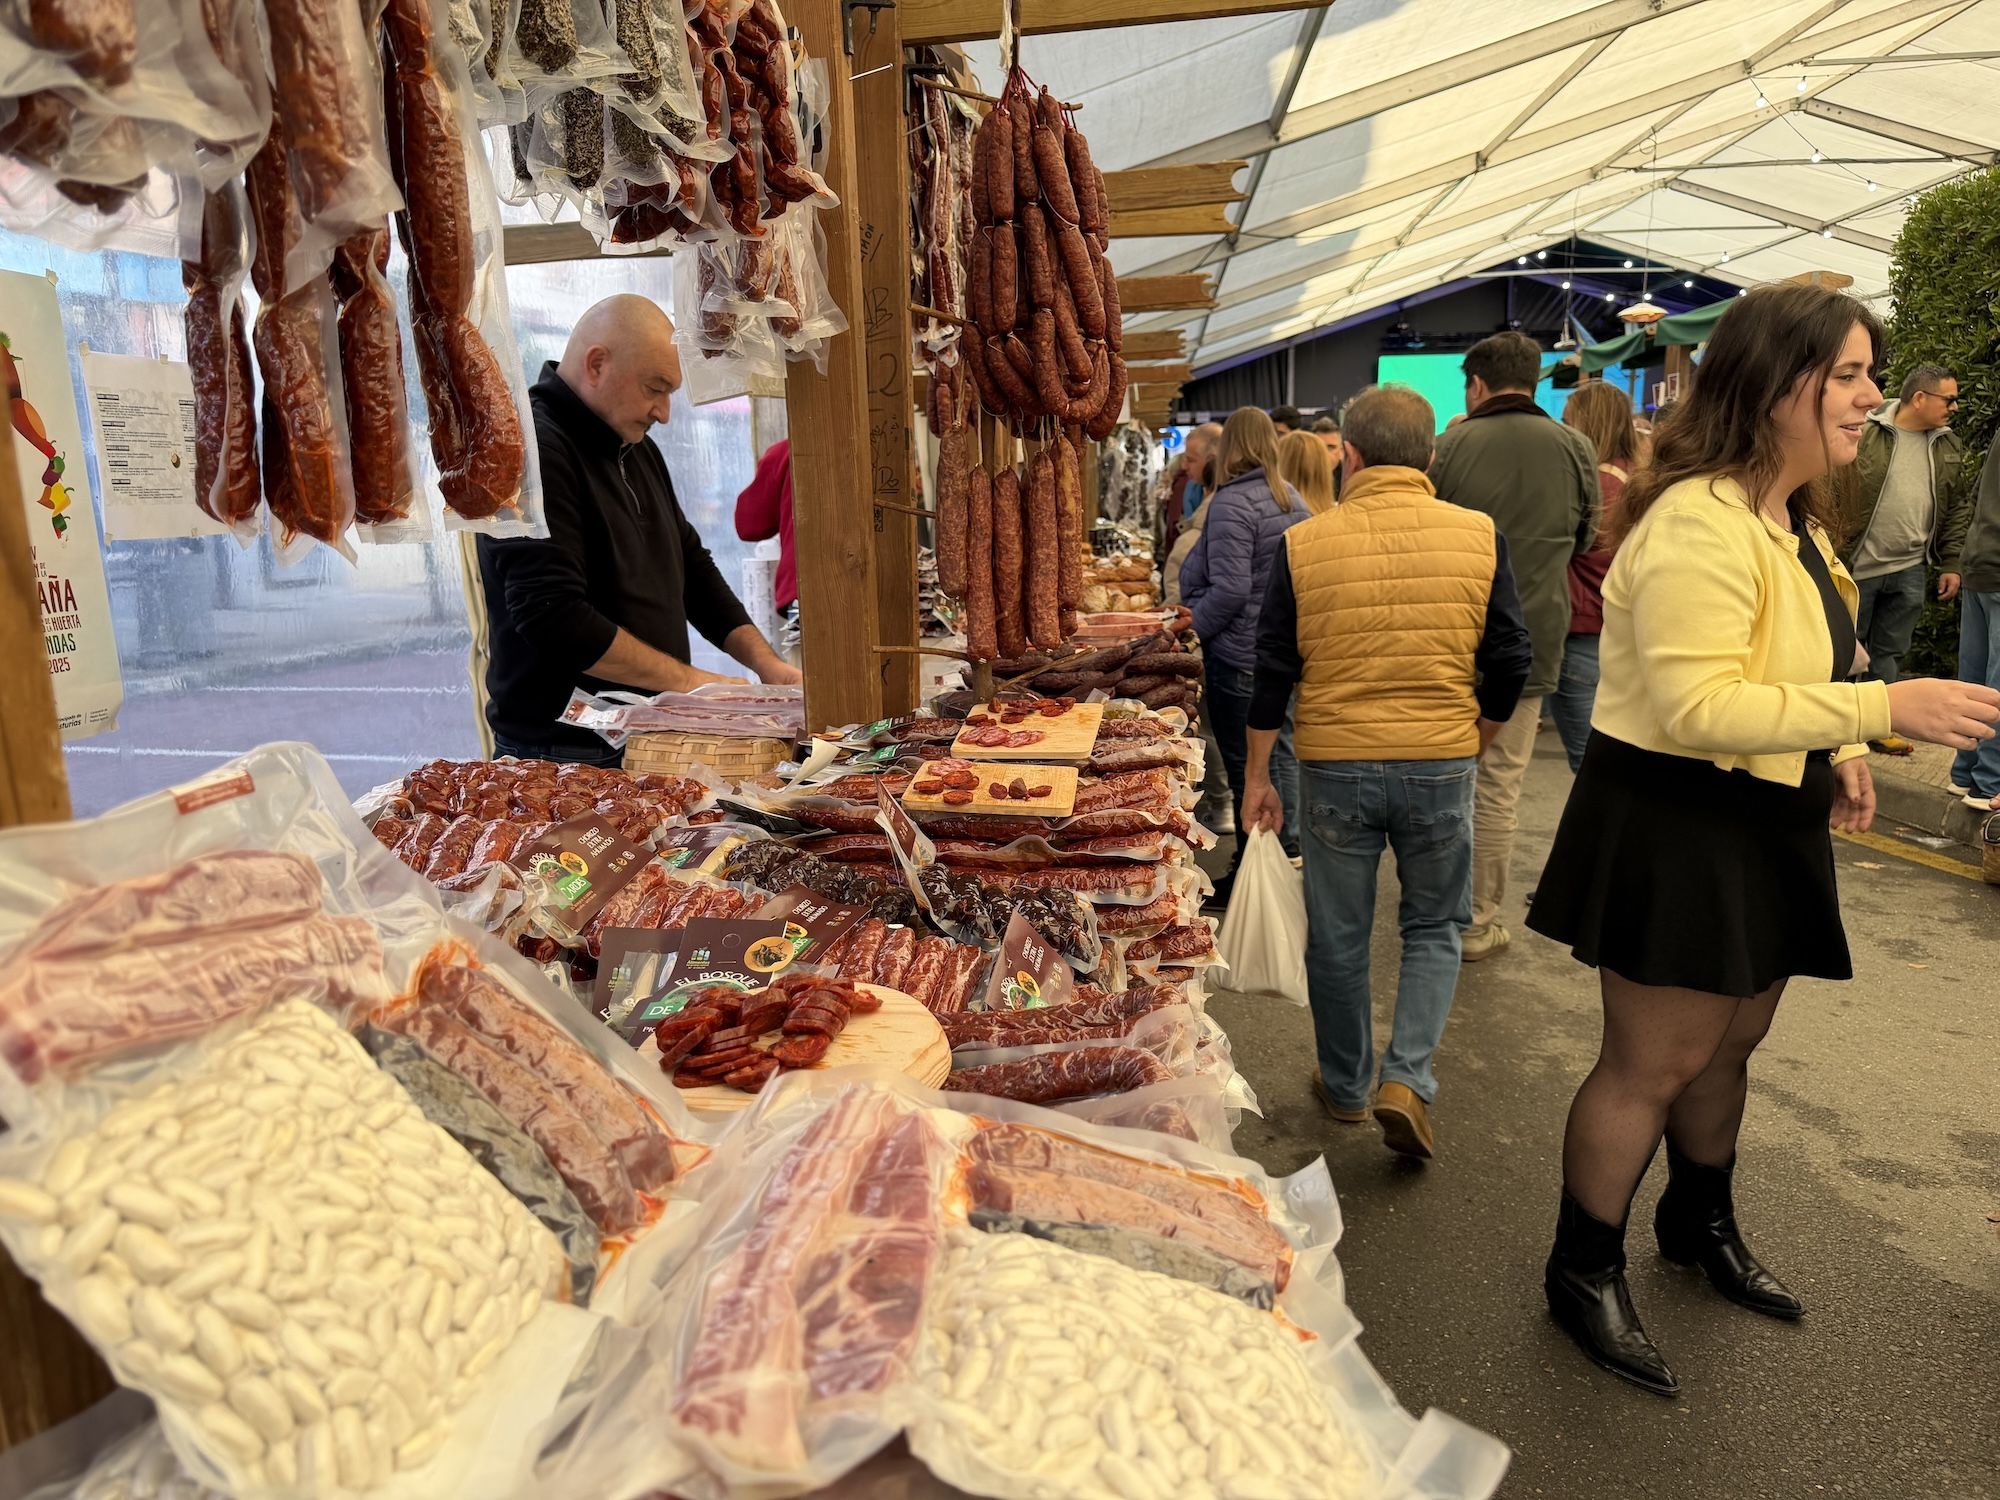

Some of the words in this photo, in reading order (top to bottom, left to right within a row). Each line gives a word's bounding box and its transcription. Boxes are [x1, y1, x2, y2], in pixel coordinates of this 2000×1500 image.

[38, 574, 78, 614] AÑA
[51, 614, 82, 632] HUERTA
[45, 633, 77, 655] NDAS
[49, 657, 71, 674] 2025
[58, 719, 82, 730] sturias
[578, 826, 600, 845] CHORIZO
[586, 834, 604, 849] EXTRA
[590, 836, 615, 858] AHUMADO
[675, 977, 696, 986] EL
[700, 970, 760, 988] BOSQUE
[649, 1005, 674, 1016] DE
